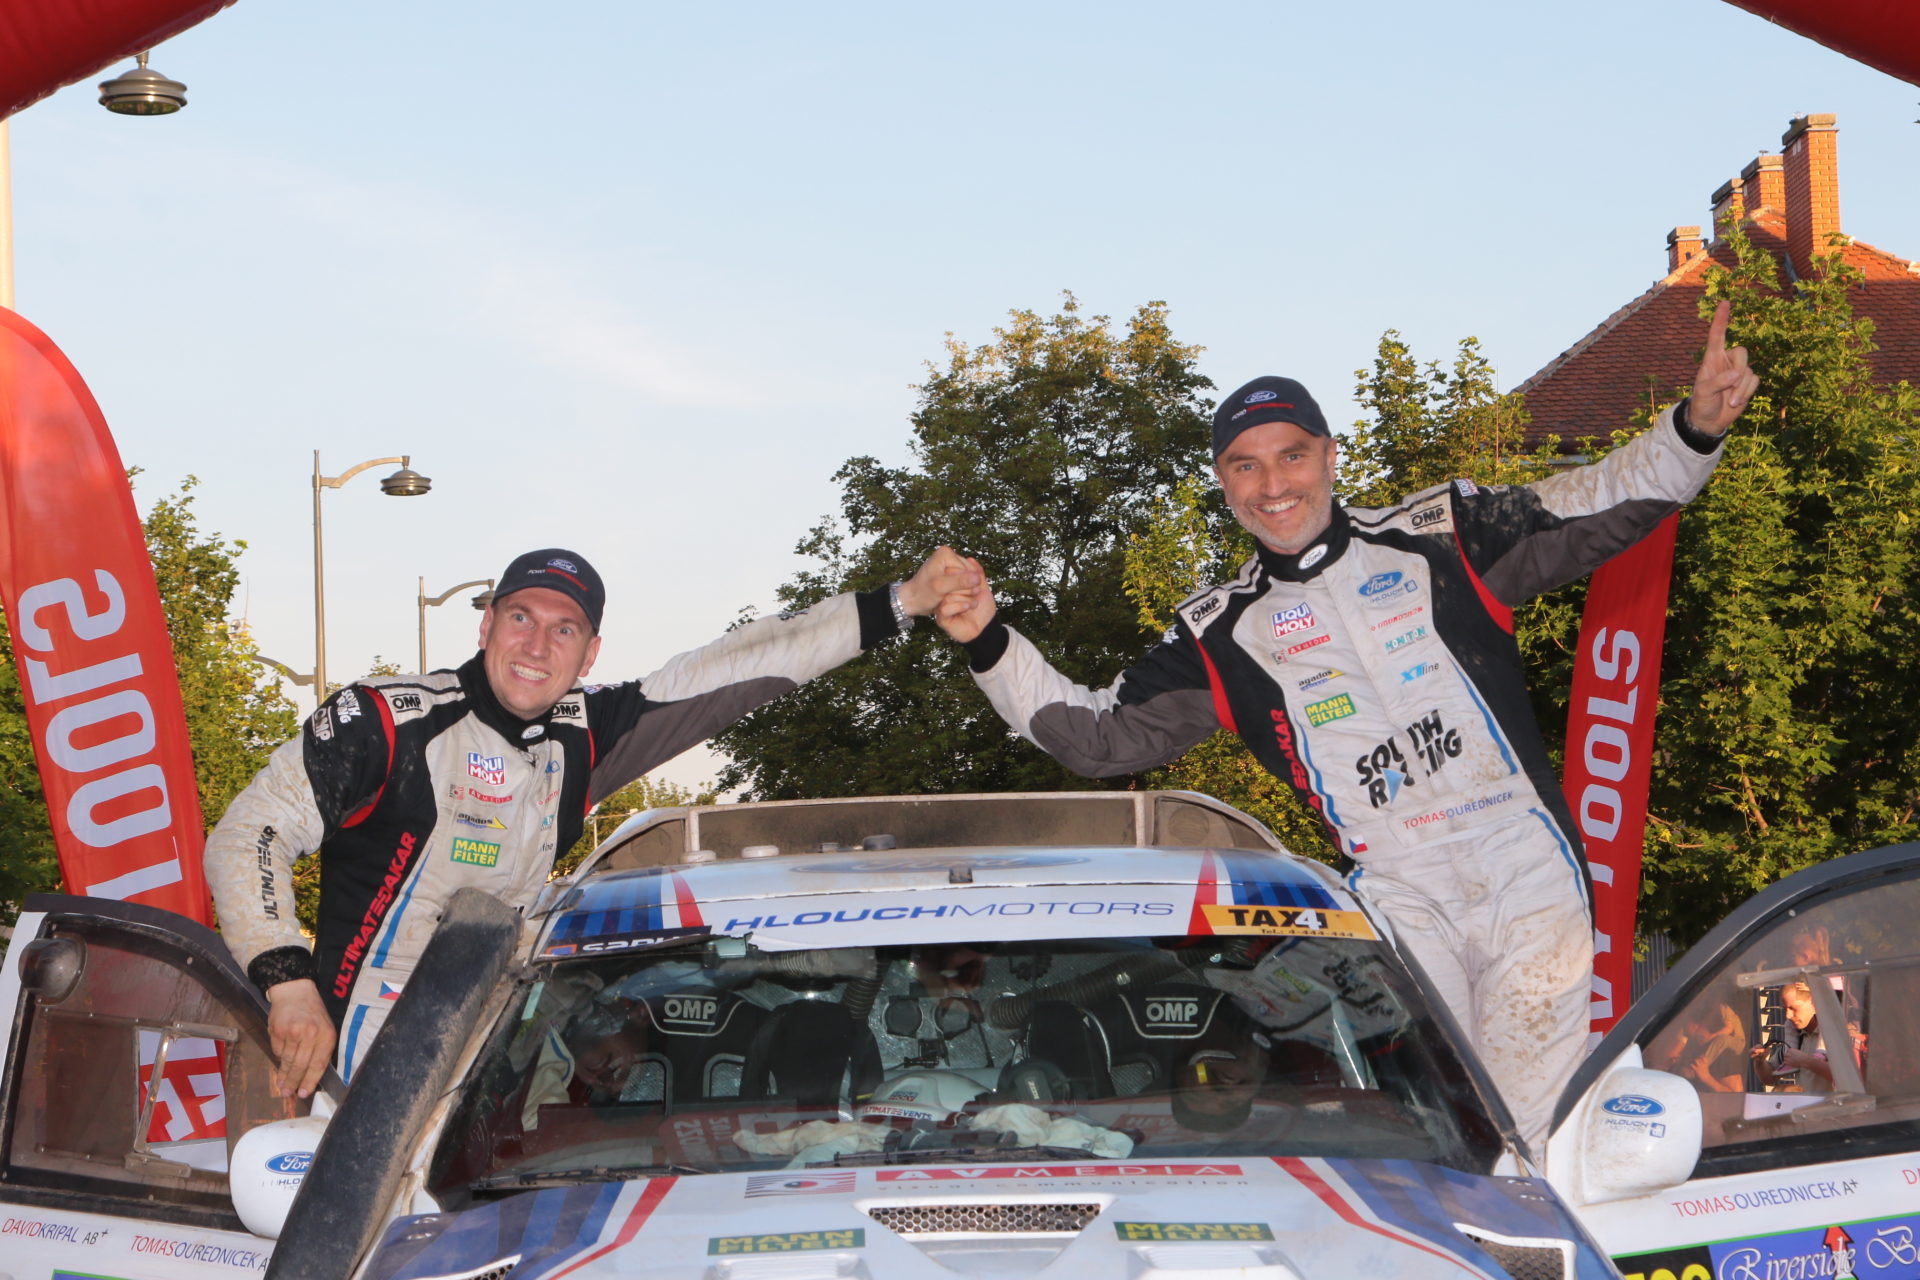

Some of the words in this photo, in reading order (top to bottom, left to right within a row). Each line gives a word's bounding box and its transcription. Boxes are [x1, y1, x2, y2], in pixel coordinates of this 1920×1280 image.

[1411, 507, 1445, 527] OMP
[1304, 551, 1323, 567] Ford
[1366, 575, 1395, 594] Ford
[1191, 598, 1220, 622] OMP
[1274, 603, 1310, 624] LIQUI
[1275, 616, 1315, 637] MOLY
[1298, 669, 1332, 687] agados
[392, 695, 422, 711] OMP
[1306, 695, 1350, 716] MANN
[314, 707, 331, 741] OMP
[1310, 705, 1354, 727] FILTER
[1356, 708, 1444, 787] SOUTH
[469, 753, 503, 771] LIQUI
[469, 765, 505, 785] MOLY
[457, 812, 494, 826] agados
[455, 839, 499, 854] MANN
[453, 850, 497, 866] FILTER
[724, 901, 1176, 932] HLOUCHMOTORS
[664, 999, 717, 1020] OMP
[1145, 1002, 1199, 1023] OMP
[1611, 1095, 1650, 1115] Ford
[279, 1154, 312, 1171] For
[278, 1177, 301, 1186] HLO
[1672, 1180, 1841, 1217] TOMASOUREDNICEK
[1, 1217, 78, 1244] DAVIDKRIPAL
[718, 1230, 854, 1246] MANN
[1124, 1223, 1260, 1233] MANN
[1126, 1231, 1265, 1240] FILTER
[130, 1235, 257, 1270] TOMASOUREDNICEK
[718, 1239, 855, 1254] FILTER
